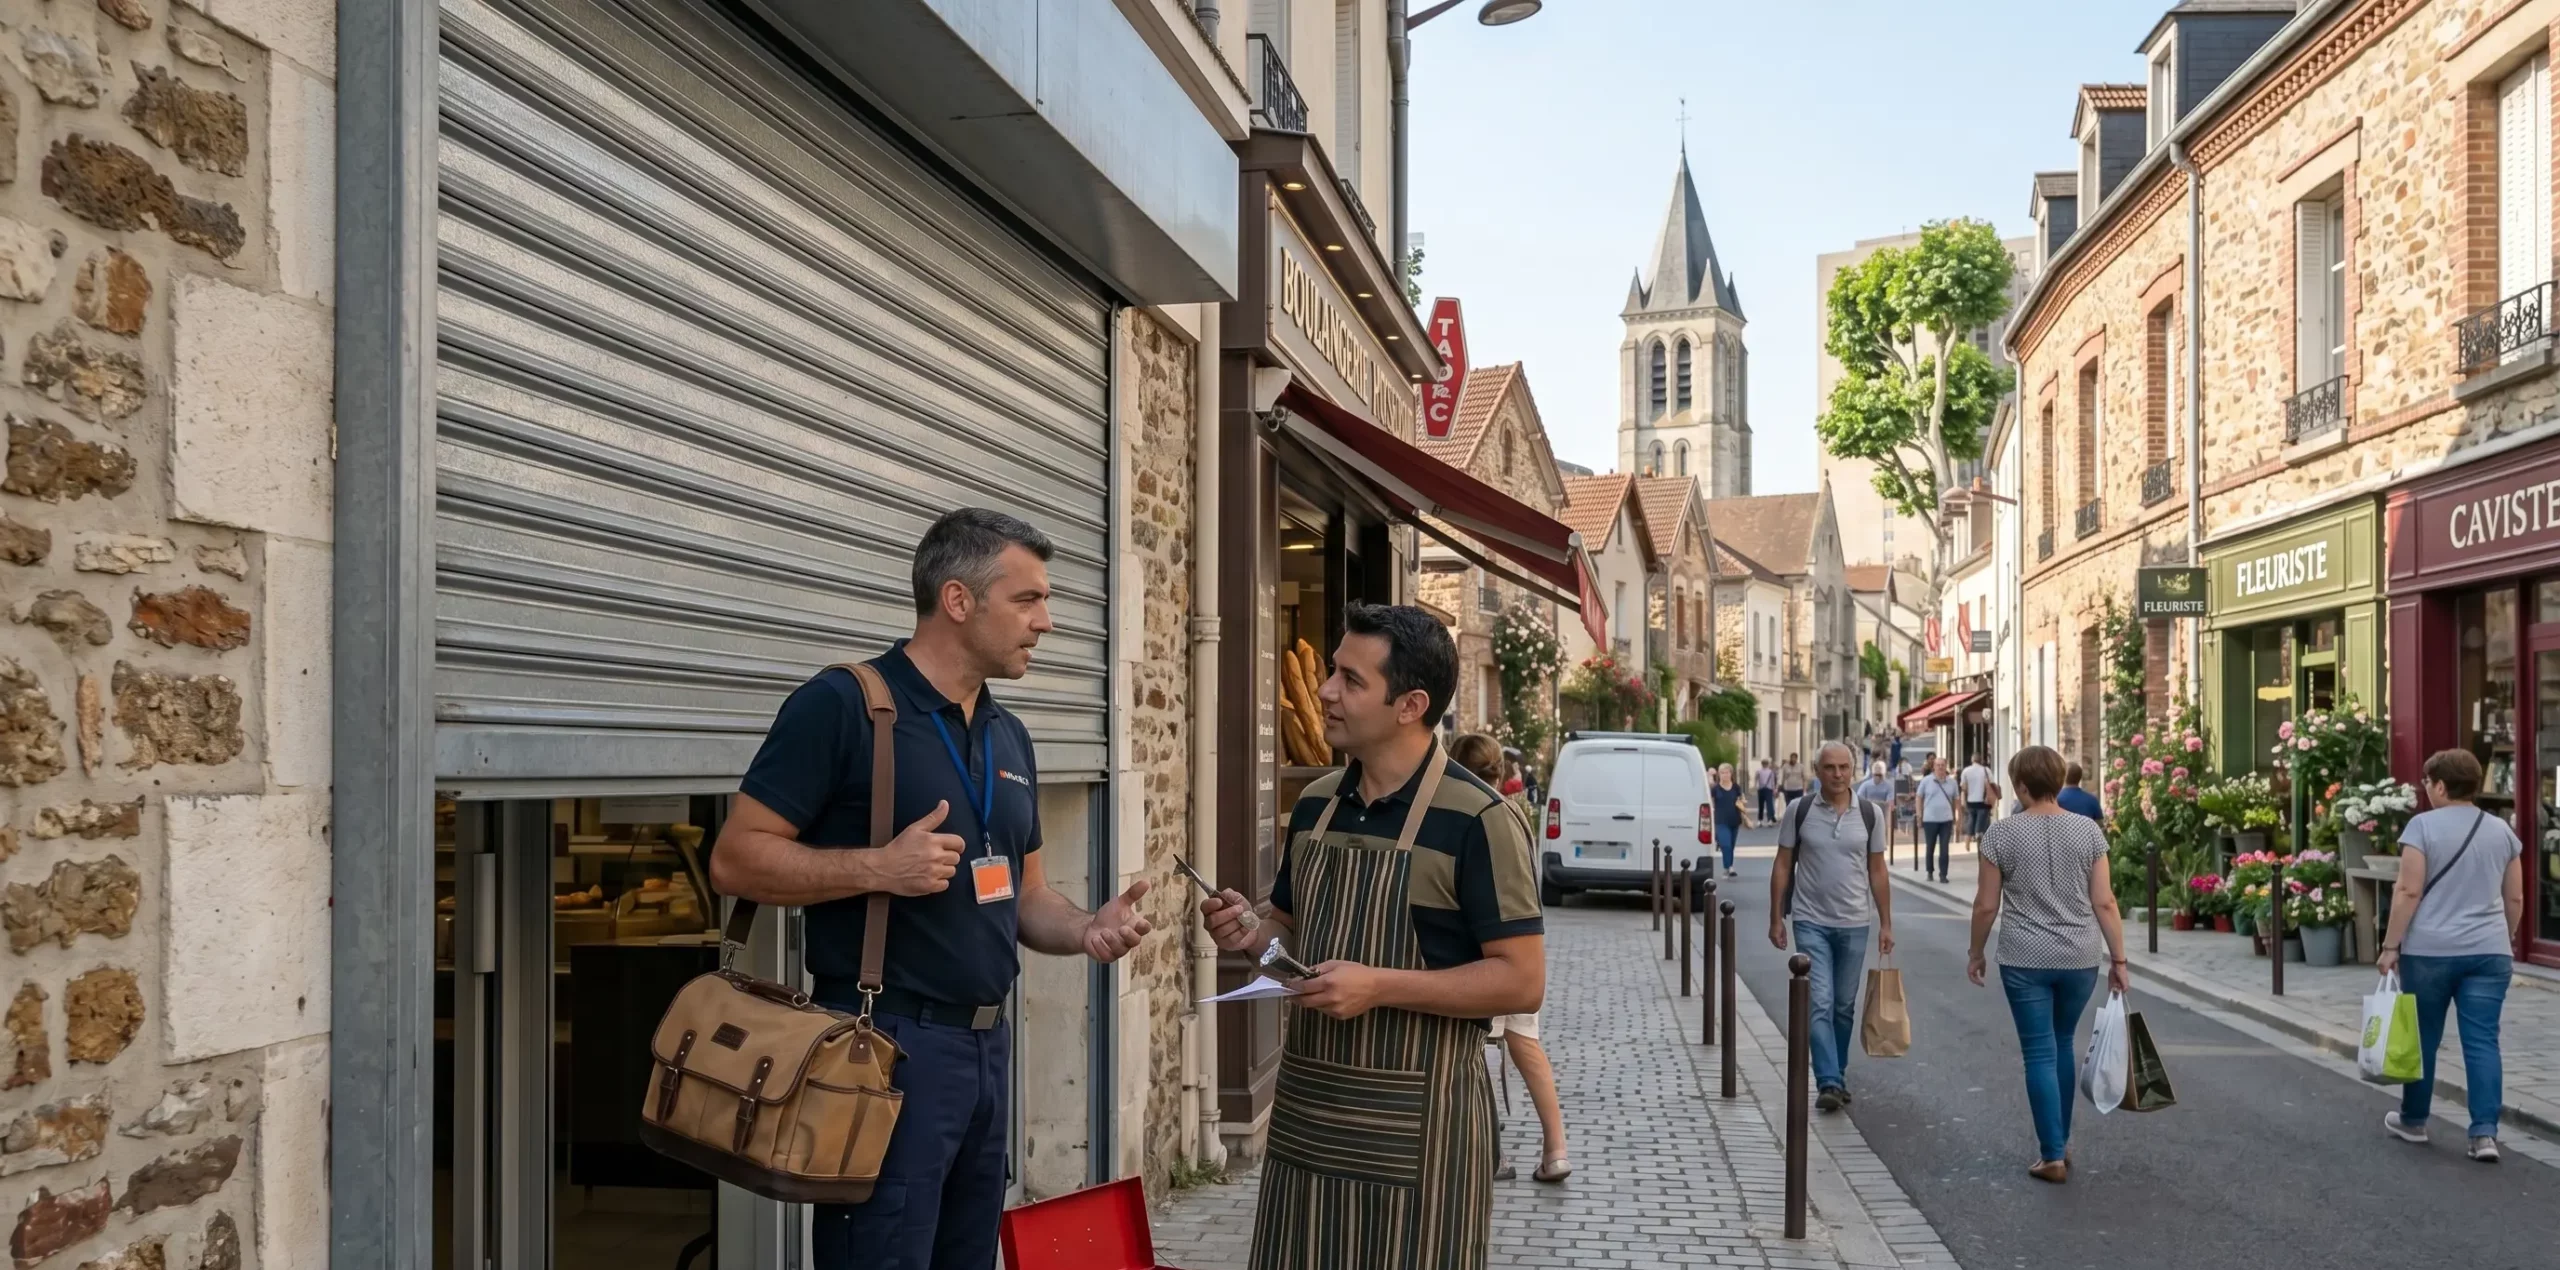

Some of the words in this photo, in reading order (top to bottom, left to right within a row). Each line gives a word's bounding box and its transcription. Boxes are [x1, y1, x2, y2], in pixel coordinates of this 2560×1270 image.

[1282, 247, 1369, 405] BOULANGERIE
[2449, 480, 2560, 549] CAVISTE
[2236, 540, 2328, 598] FLEURISTE
[2144, 600, 2205, 613] FLEURISTE
